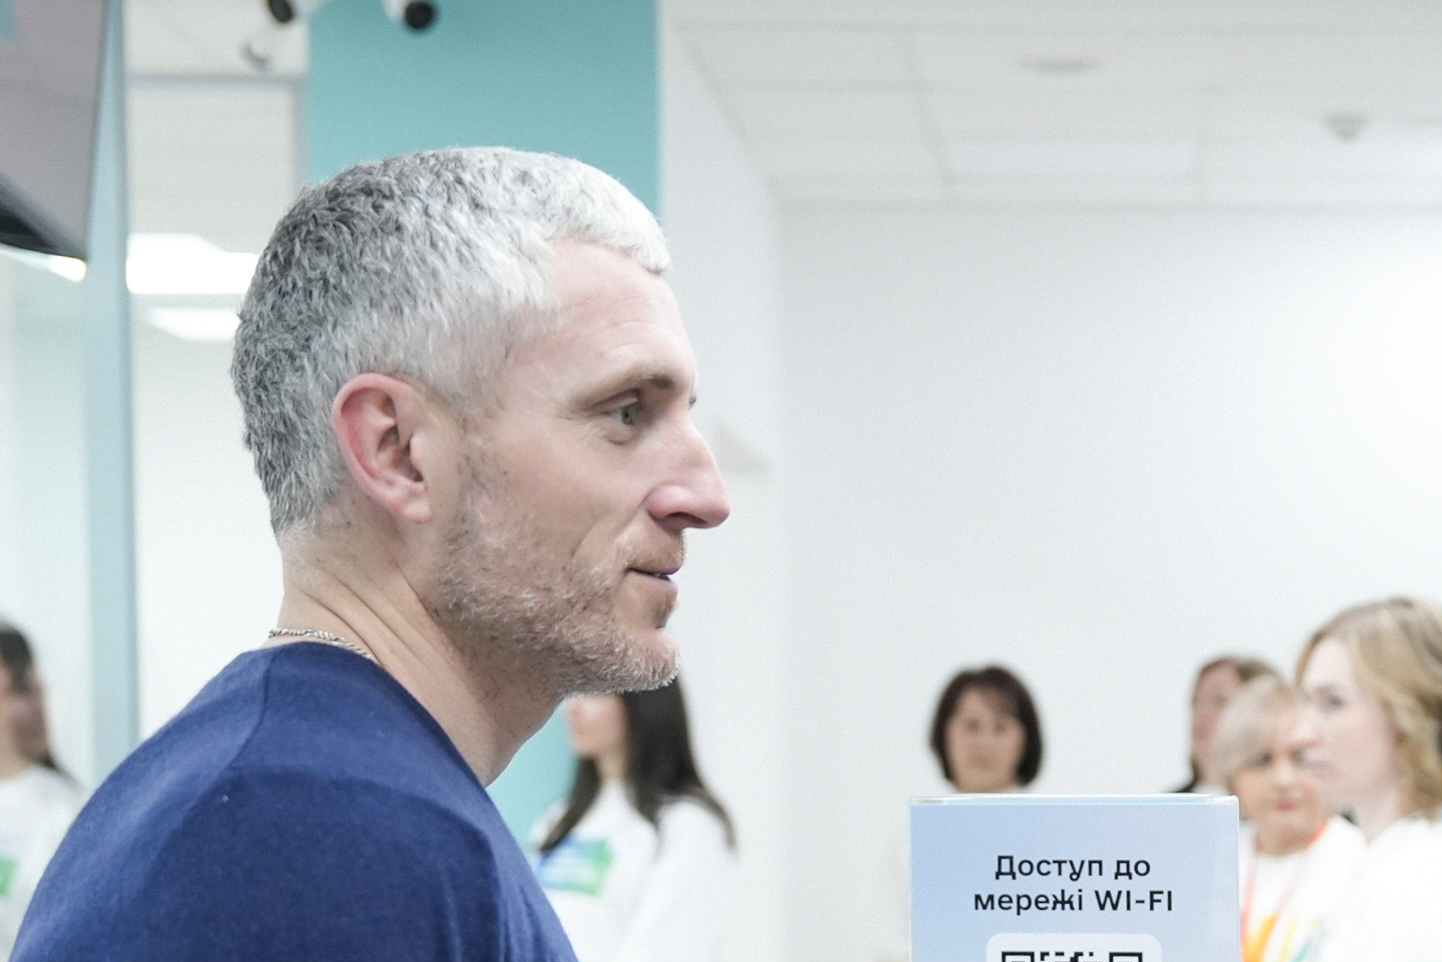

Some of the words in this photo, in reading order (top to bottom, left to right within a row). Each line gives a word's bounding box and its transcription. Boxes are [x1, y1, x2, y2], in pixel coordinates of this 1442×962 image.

[995, 855, 1103, 881] Доступ
[1114, 859, 1151, 880] до
[974, 889, 1083, 915] мережі
[1094, 890, 1172, 911] WI-FI
